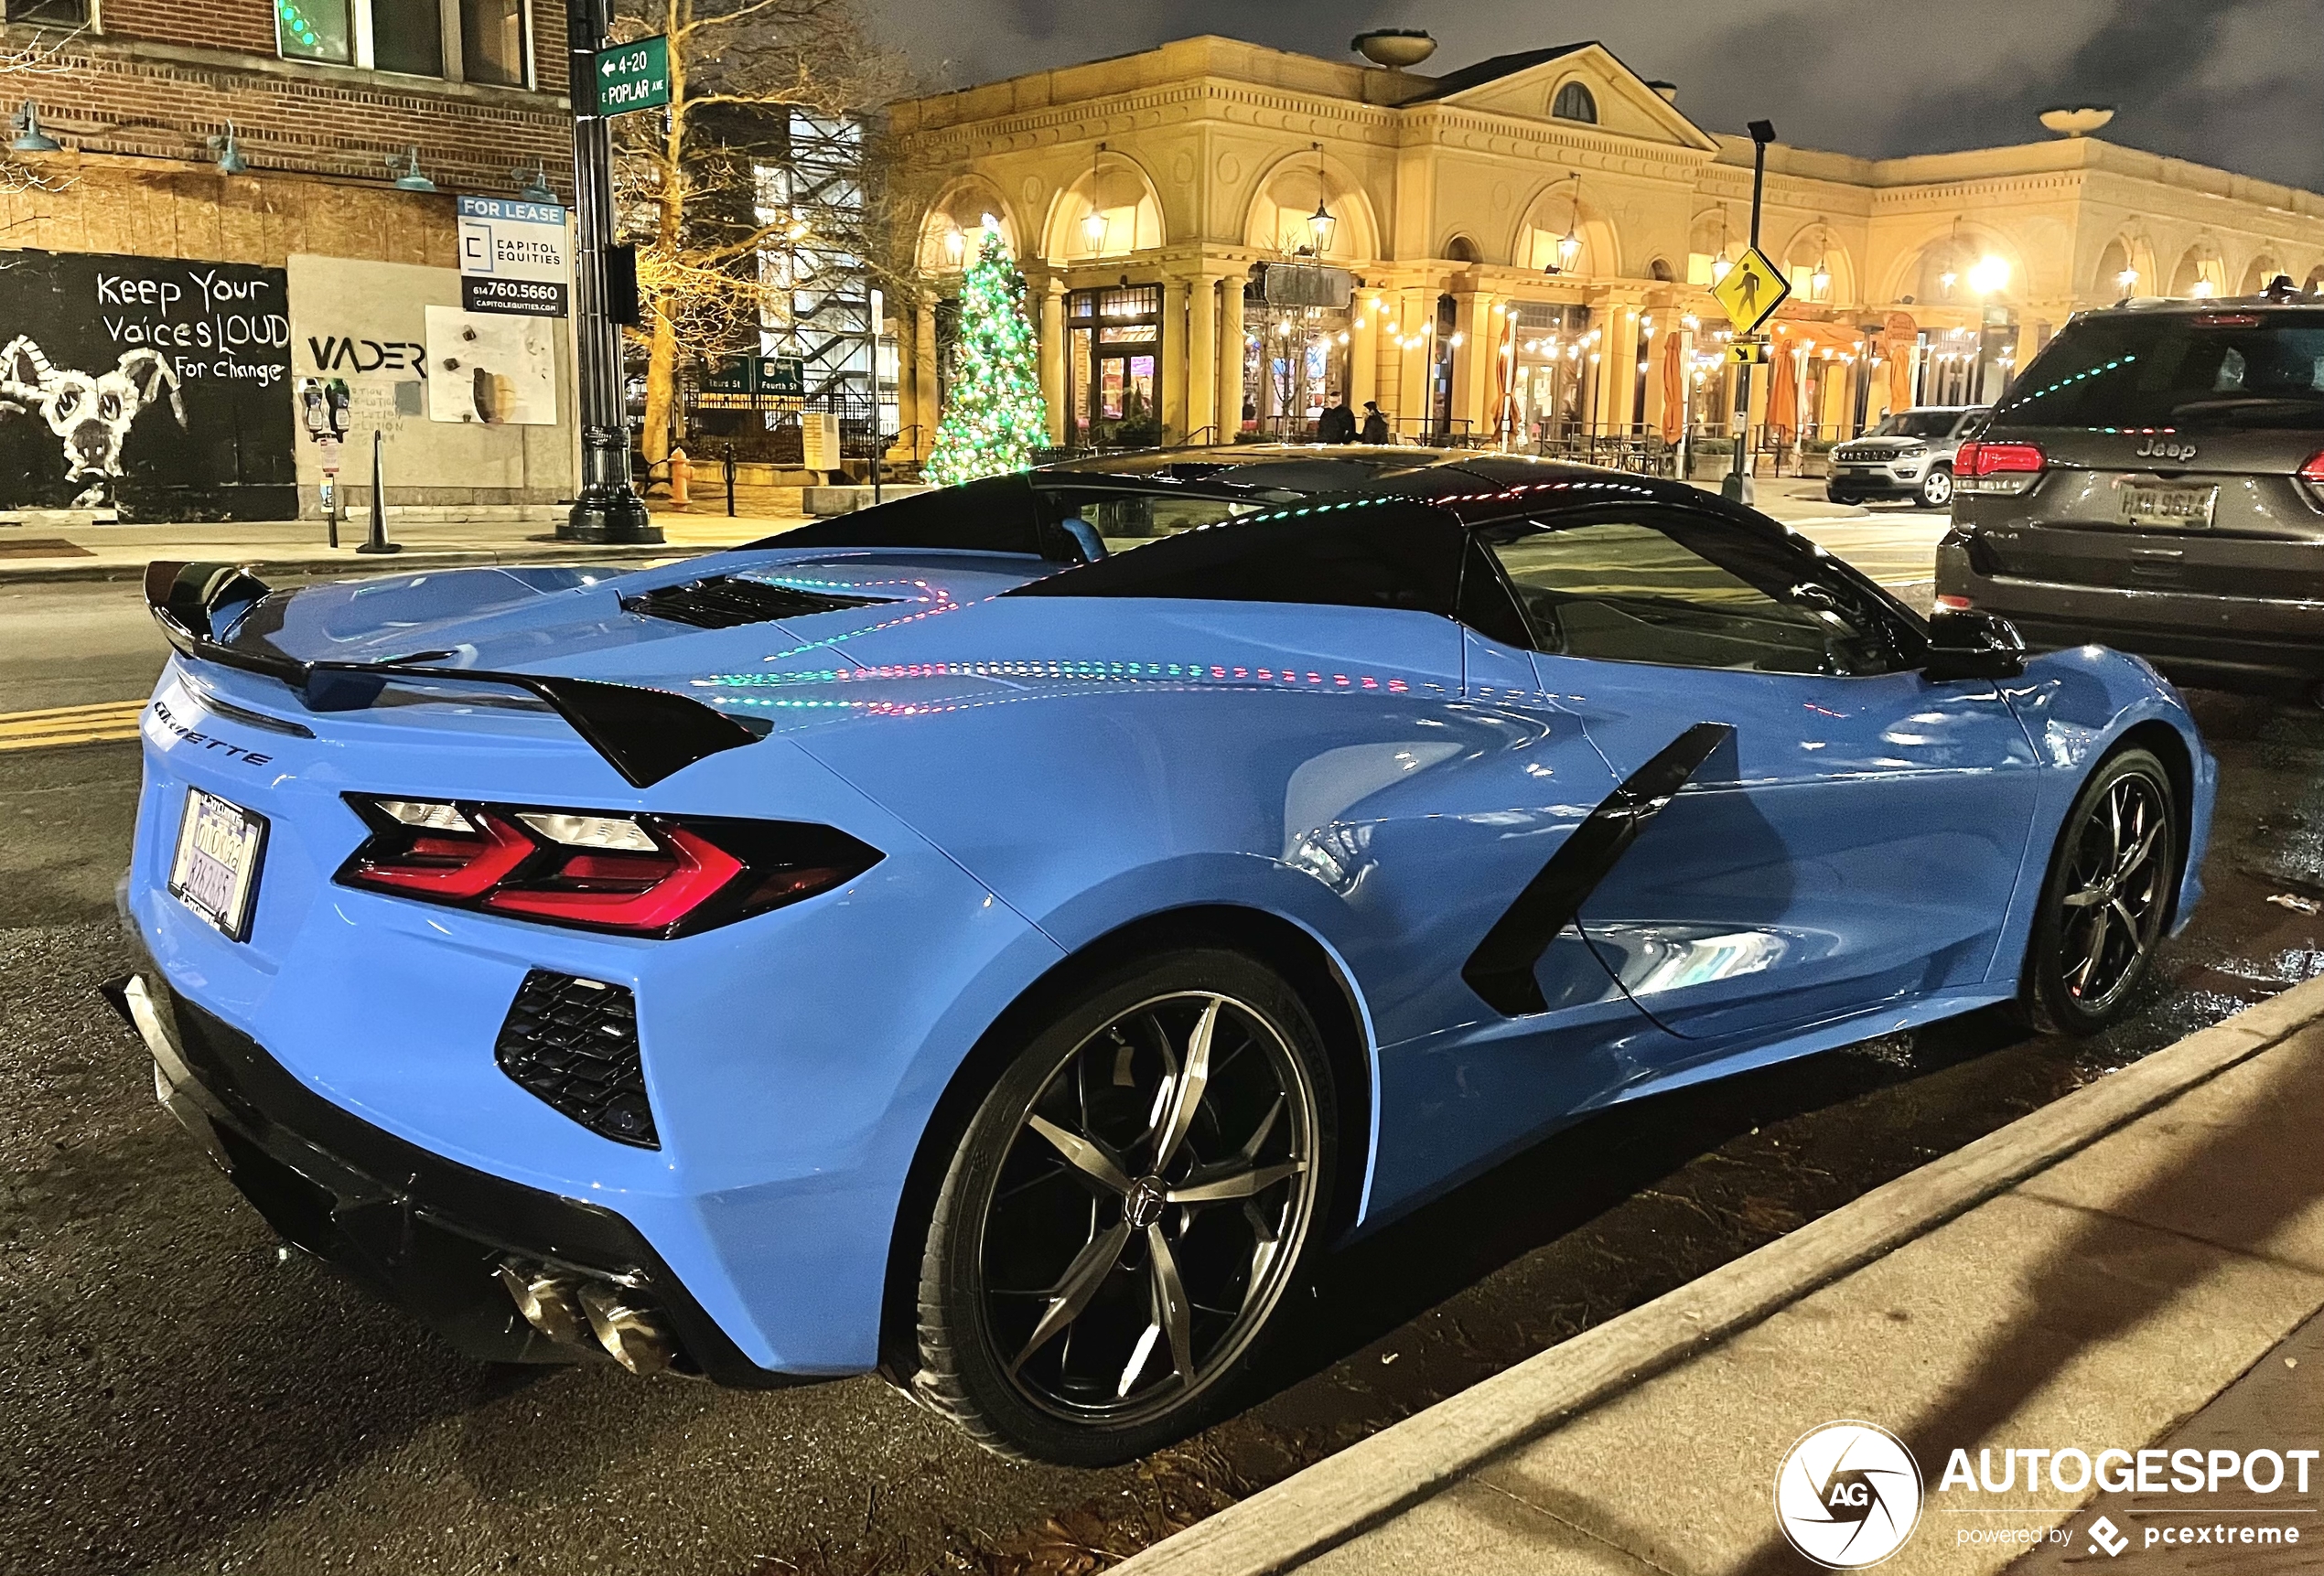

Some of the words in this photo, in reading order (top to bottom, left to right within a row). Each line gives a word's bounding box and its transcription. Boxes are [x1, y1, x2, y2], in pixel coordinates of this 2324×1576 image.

[619, 50, 648, 74] 4-20
[602, 92, 607, 102] E
[608, 80, 650, 105] POPLAR
[651, 80, 664, 91] AVE
[463, 199, 500, 217] FOR
[505, 204, 560, 222] LEASE
[497, 240, 557, 253] CAPITOL
[498, 252, 561, 265] EQUITIES
[97, 273, 182, 317] Keep
[188, 269, 269, 314] Your
[102, 316, 212, 348] Voices
[216, 314, 290, 355] LOUD
[175, 356, 208, 383] For
[307, 336, 427, 380] VADER
[732, 380, 740, 388] St
[761, 381, 787, 390] Fourth
[789, 382, 798, 391] St
[2136, 439, 2197, 461] Jeep
